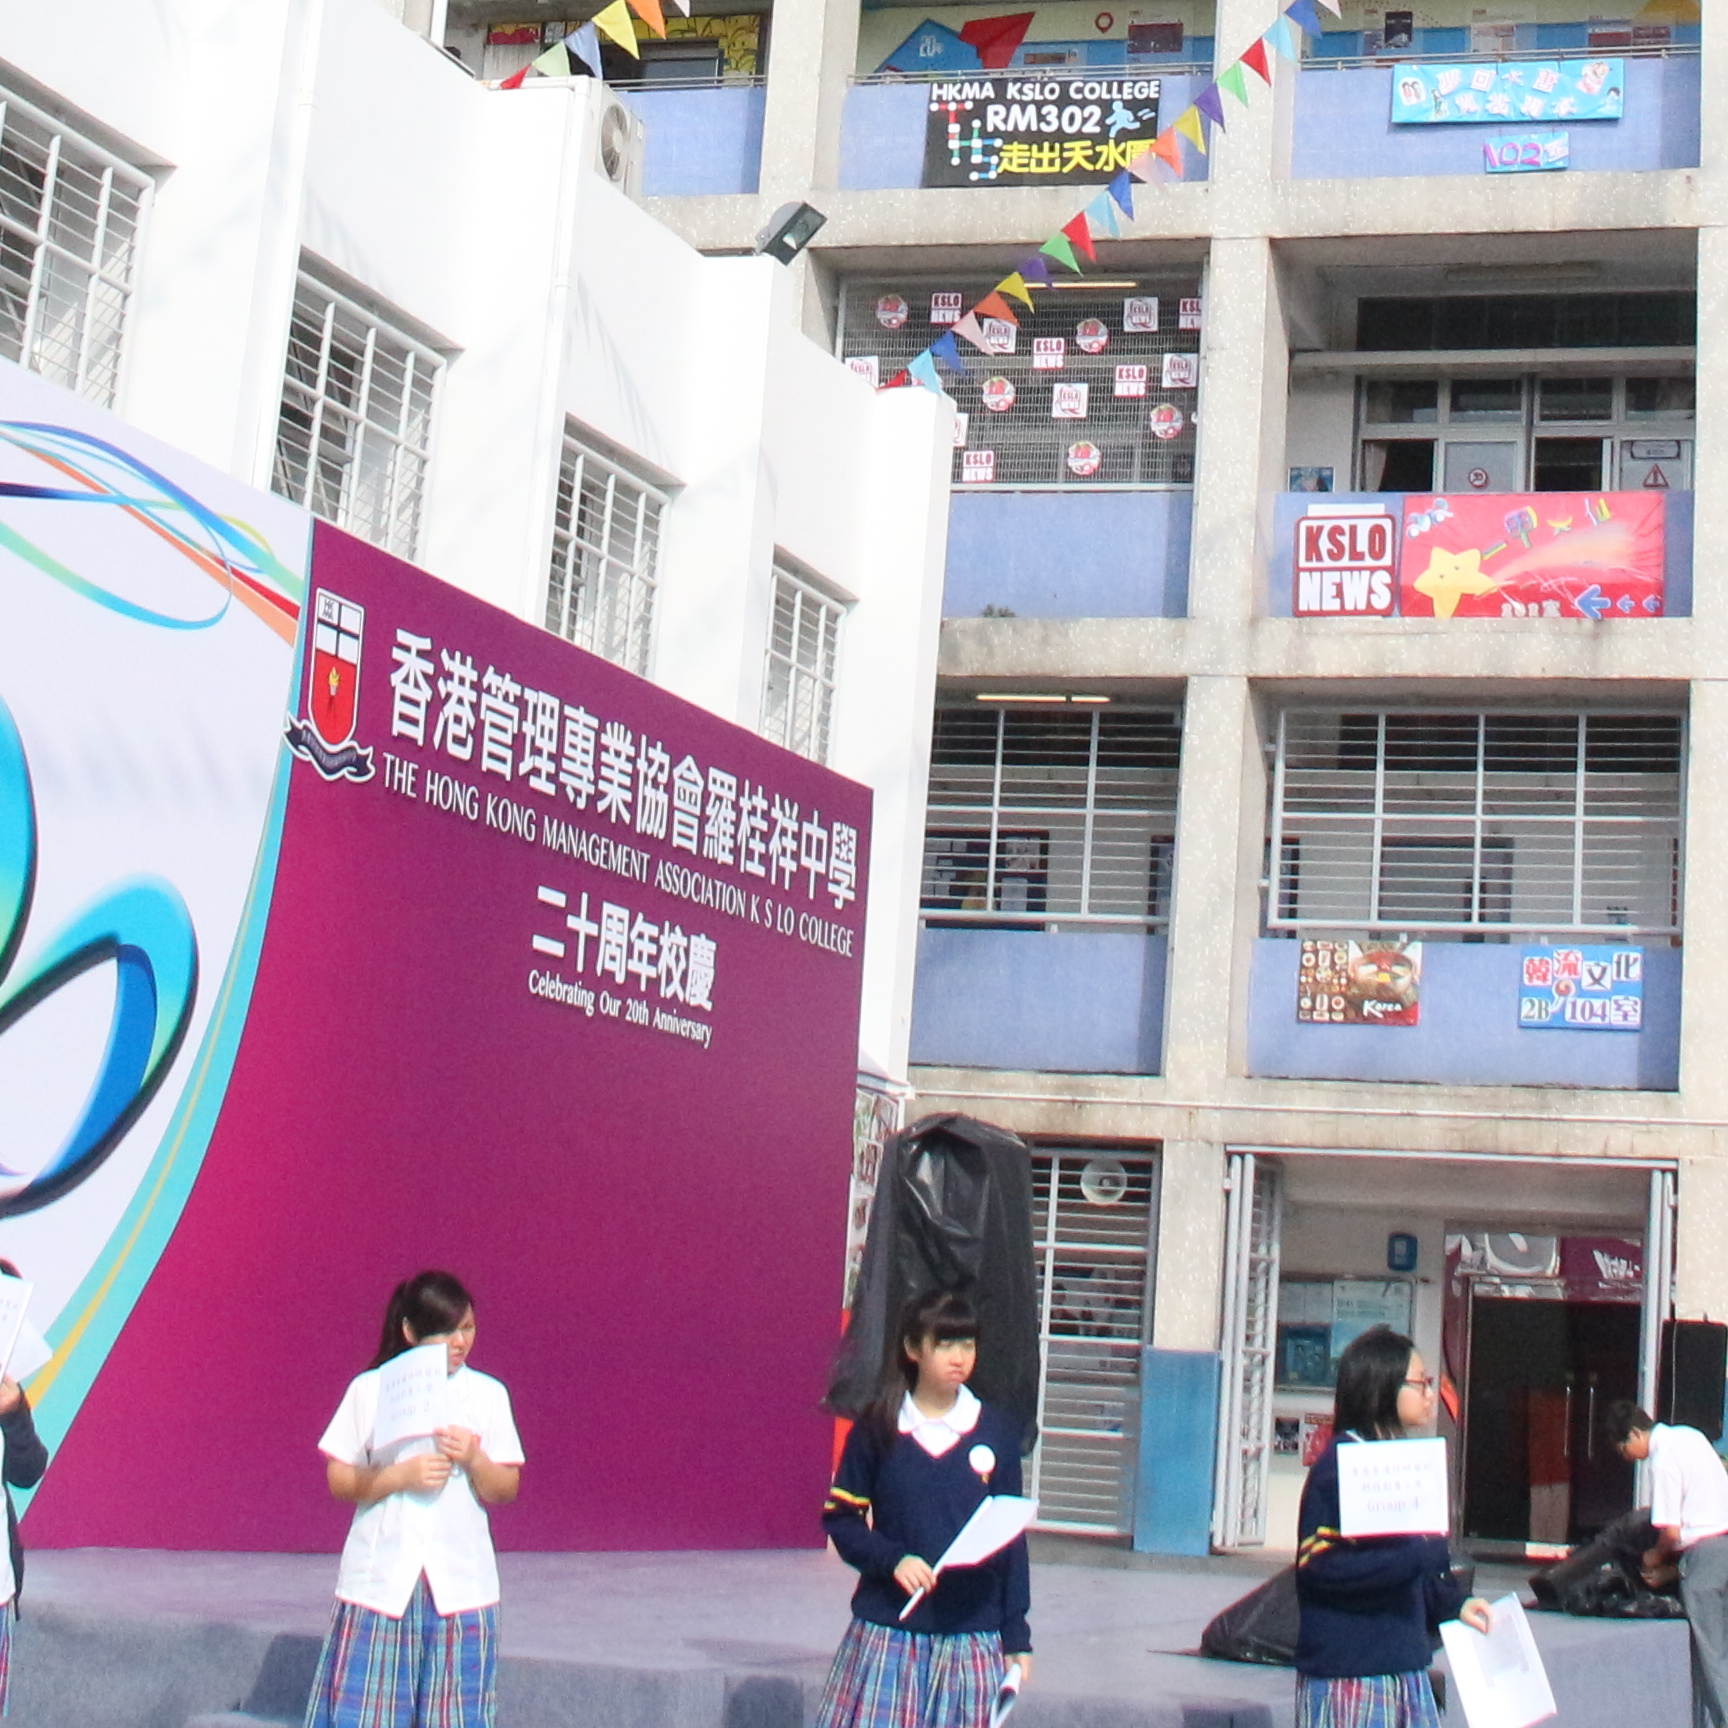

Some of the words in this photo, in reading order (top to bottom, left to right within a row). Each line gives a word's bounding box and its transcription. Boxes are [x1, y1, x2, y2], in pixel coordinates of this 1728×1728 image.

[932, 82, 995, 101] HKMA
[1007, 81, 1060, 100] KSLO
[1069, 80, 1161, 100] COLLEGE
[986, 103, 1102, 134] RM302
[934, 294, 960, 306] KSLO
[1181, 297, 1201, 313] KSL
[1035, 339, 1062, 353] KSLO
[1118, 367, 1145, 379] KSLO
[965, 454, 992, 466] KSLO
[1305, 524, 1386, 562] KSLO
[1299, 569, 1392, 610] NEWS
[390, 628, 857, 910] 香港管理專業協會羅桂祥中學
[383, 752, 419, 799] THE
[425, 769, 479, 821] HONG
[485, 793, 536, 843] KONG
[542, 815, 650, 884] MANAGEMENT
[654, 859, 747, 919] ASSOCIATION
[750, 893, 760, 924] K
[764, 898, 773, 929] S
[777, 903, 795, 937] LO
[799, 911, 854, 958] COLLEGE
[532, 885, 718, 1012] 二十周年校慶
[1522, 949, 1643, 991] 韓流文化
[528, 969, 595, 1018] Celebrating
[599, 990, 622, 1018] Our
[625, 997, 650, 1026] 20th
[652, 1006, 713, 1050] Anniversary
[1565, 995, 1640, 1024] 104室
[1366, 1499, 1406, 1513] Group
